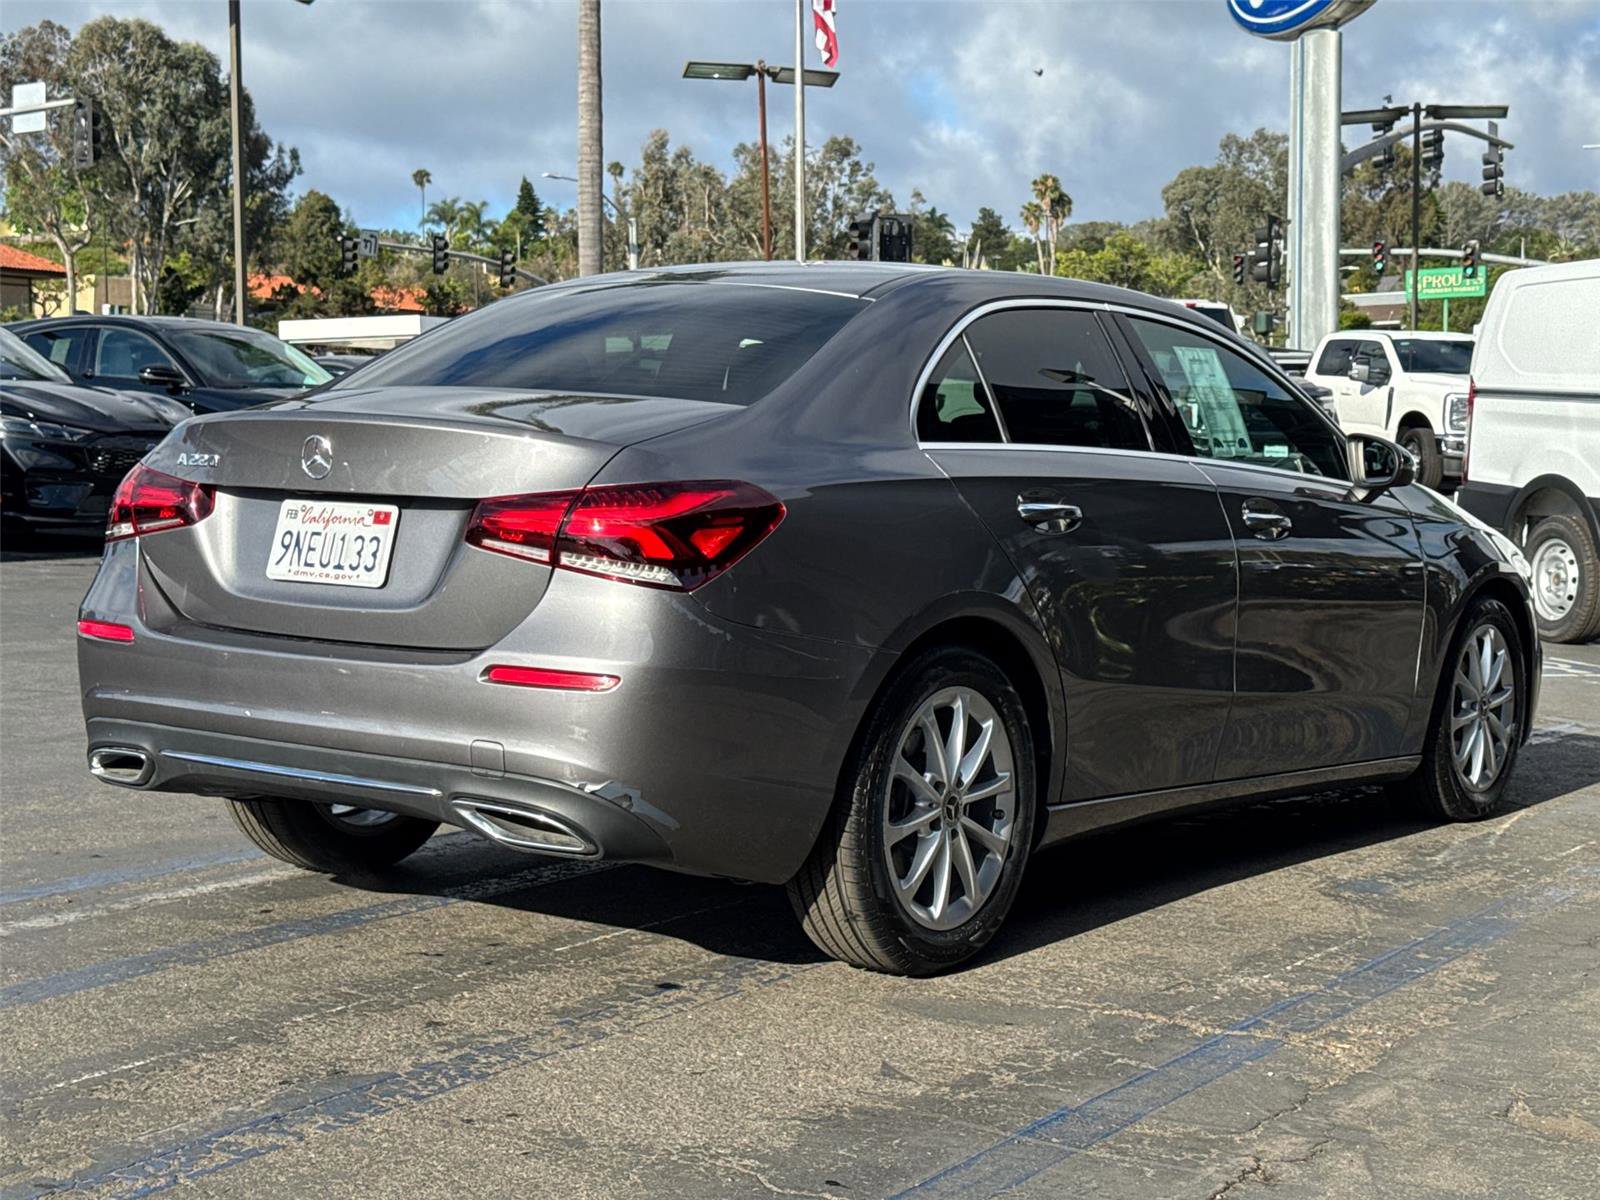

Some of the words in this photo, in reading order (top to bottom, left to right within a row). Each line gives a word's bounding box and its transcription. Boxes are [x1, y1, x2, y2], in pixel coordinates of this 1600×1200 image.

[285, 508, 299, 520] FEB
[301, 506, 372, 531] California
[275, 530, 381, 573] 9NEU133
[293, 569, 353, 580] dmv.ca.gov
